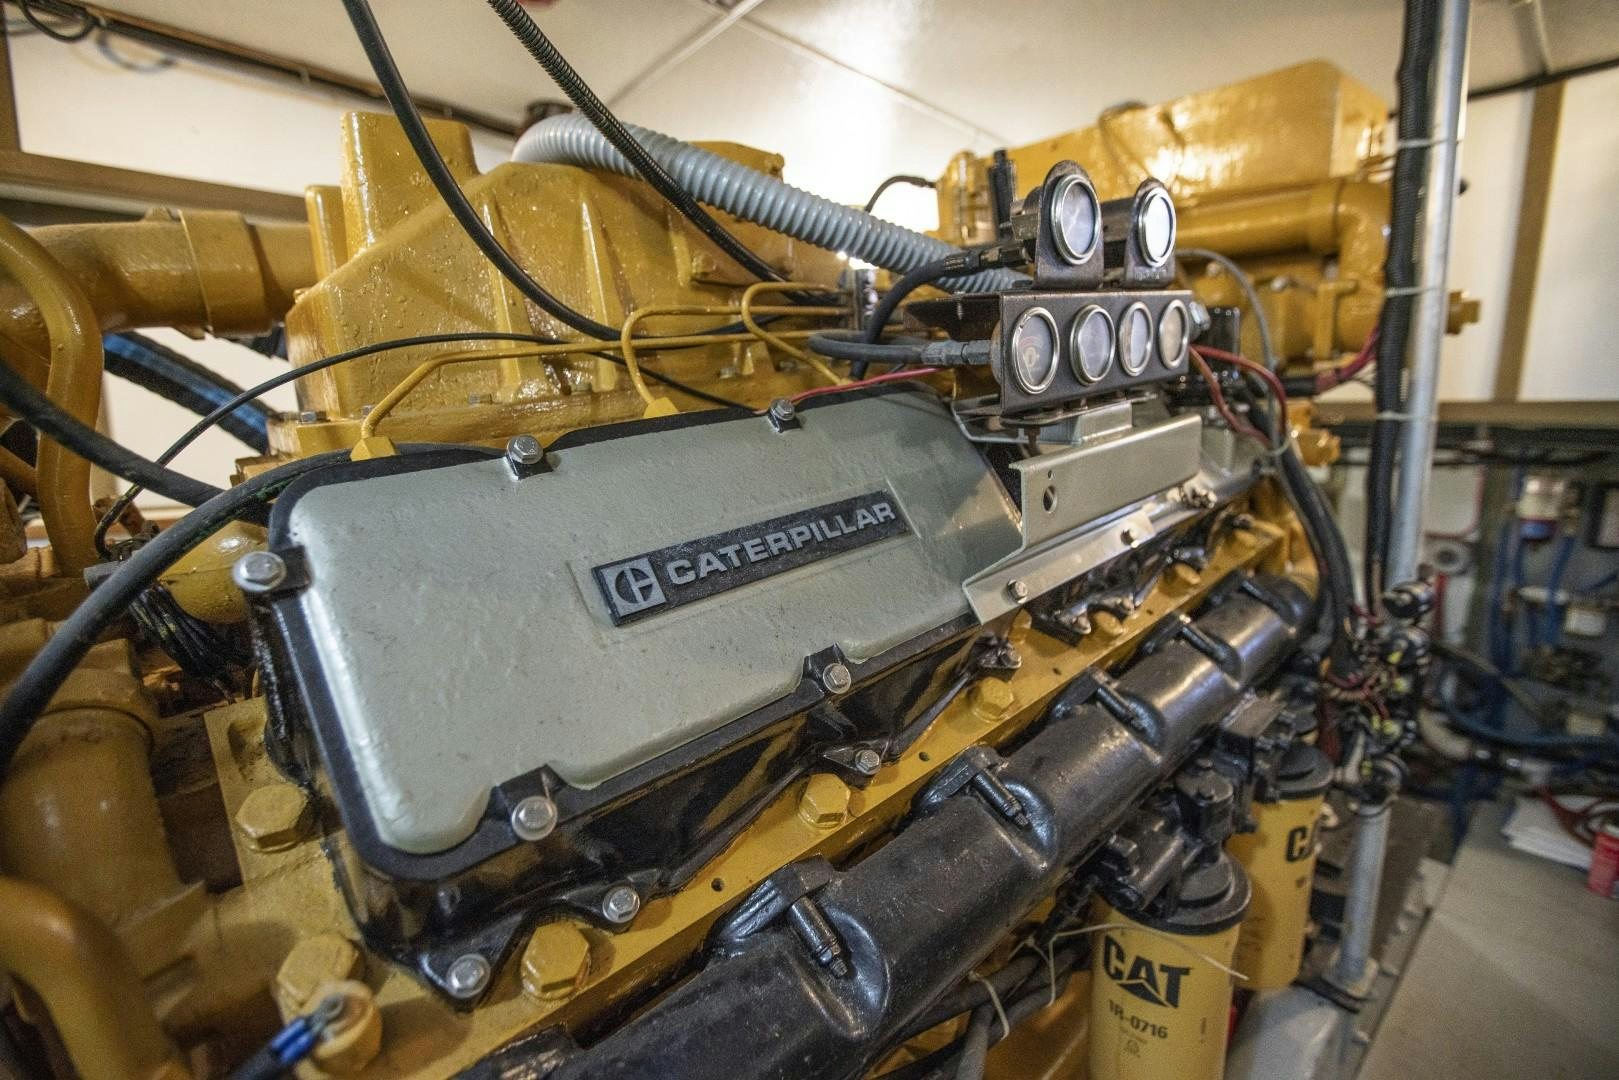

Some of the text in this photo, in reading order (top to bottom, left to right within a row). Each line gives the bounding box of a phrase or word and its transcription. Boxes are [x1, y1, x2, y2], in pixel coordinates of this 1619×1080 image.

[667, 502, 896, 585] CATERPILLAR
[1103, 935, 1191, 1008] CAT
[1109, 999, 1168, 1039] 1R-0716
